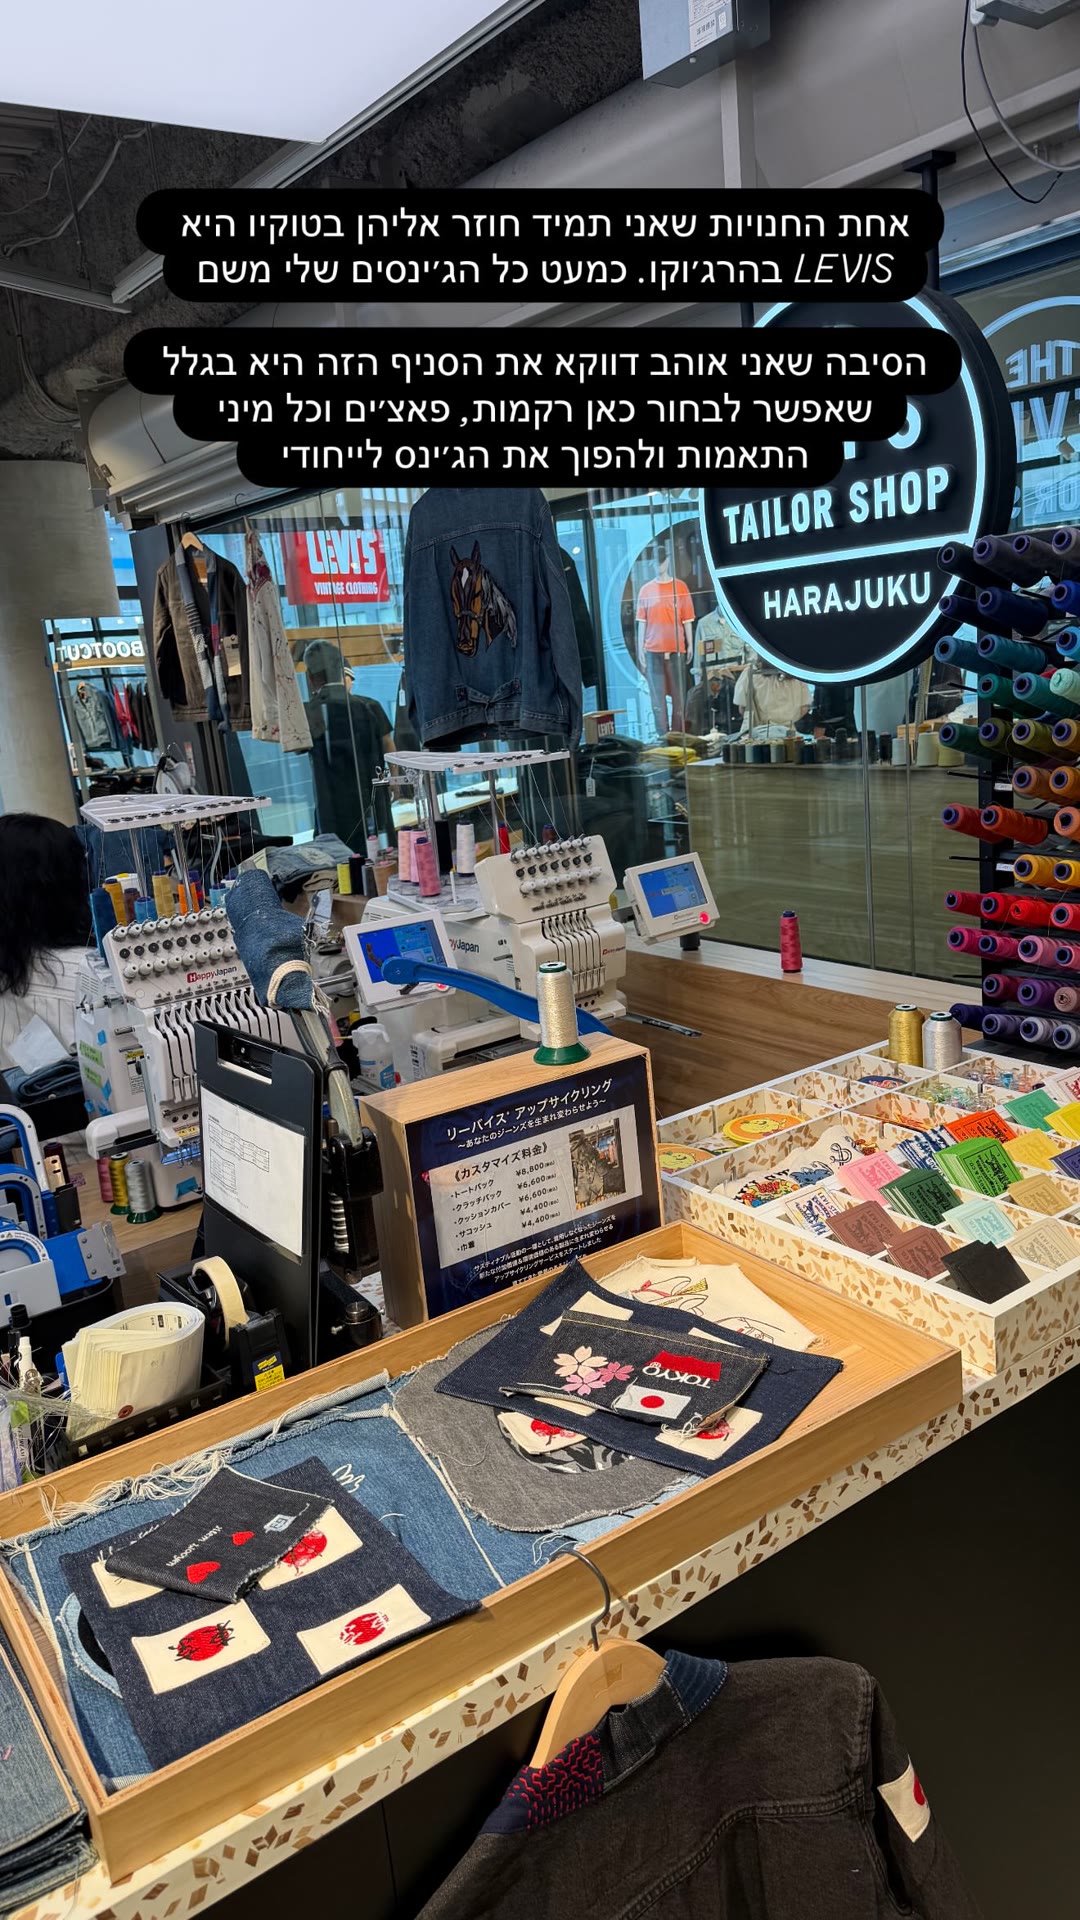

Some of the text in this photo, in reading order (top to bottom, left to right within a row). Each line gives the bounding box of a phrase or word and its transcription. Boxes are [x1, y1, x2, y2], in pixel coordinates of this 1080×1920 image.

[723, 490, 834, 545] TAILOR
[848, 465, 951, 524] SHOP
[305, 529, 378, 575] LEVI'S
[314, 581, 379, 596] VINTAGE CLOTHING
[763, 571, 932, 620] HARAJUKU
[186, 965, 237, 984] HappyJapan
[515, 1078, 613, 1120] アップサイクリング
[818, 1192, 830, 1205] LEVI
[642, 1365, 711, 1389] TOKYO
